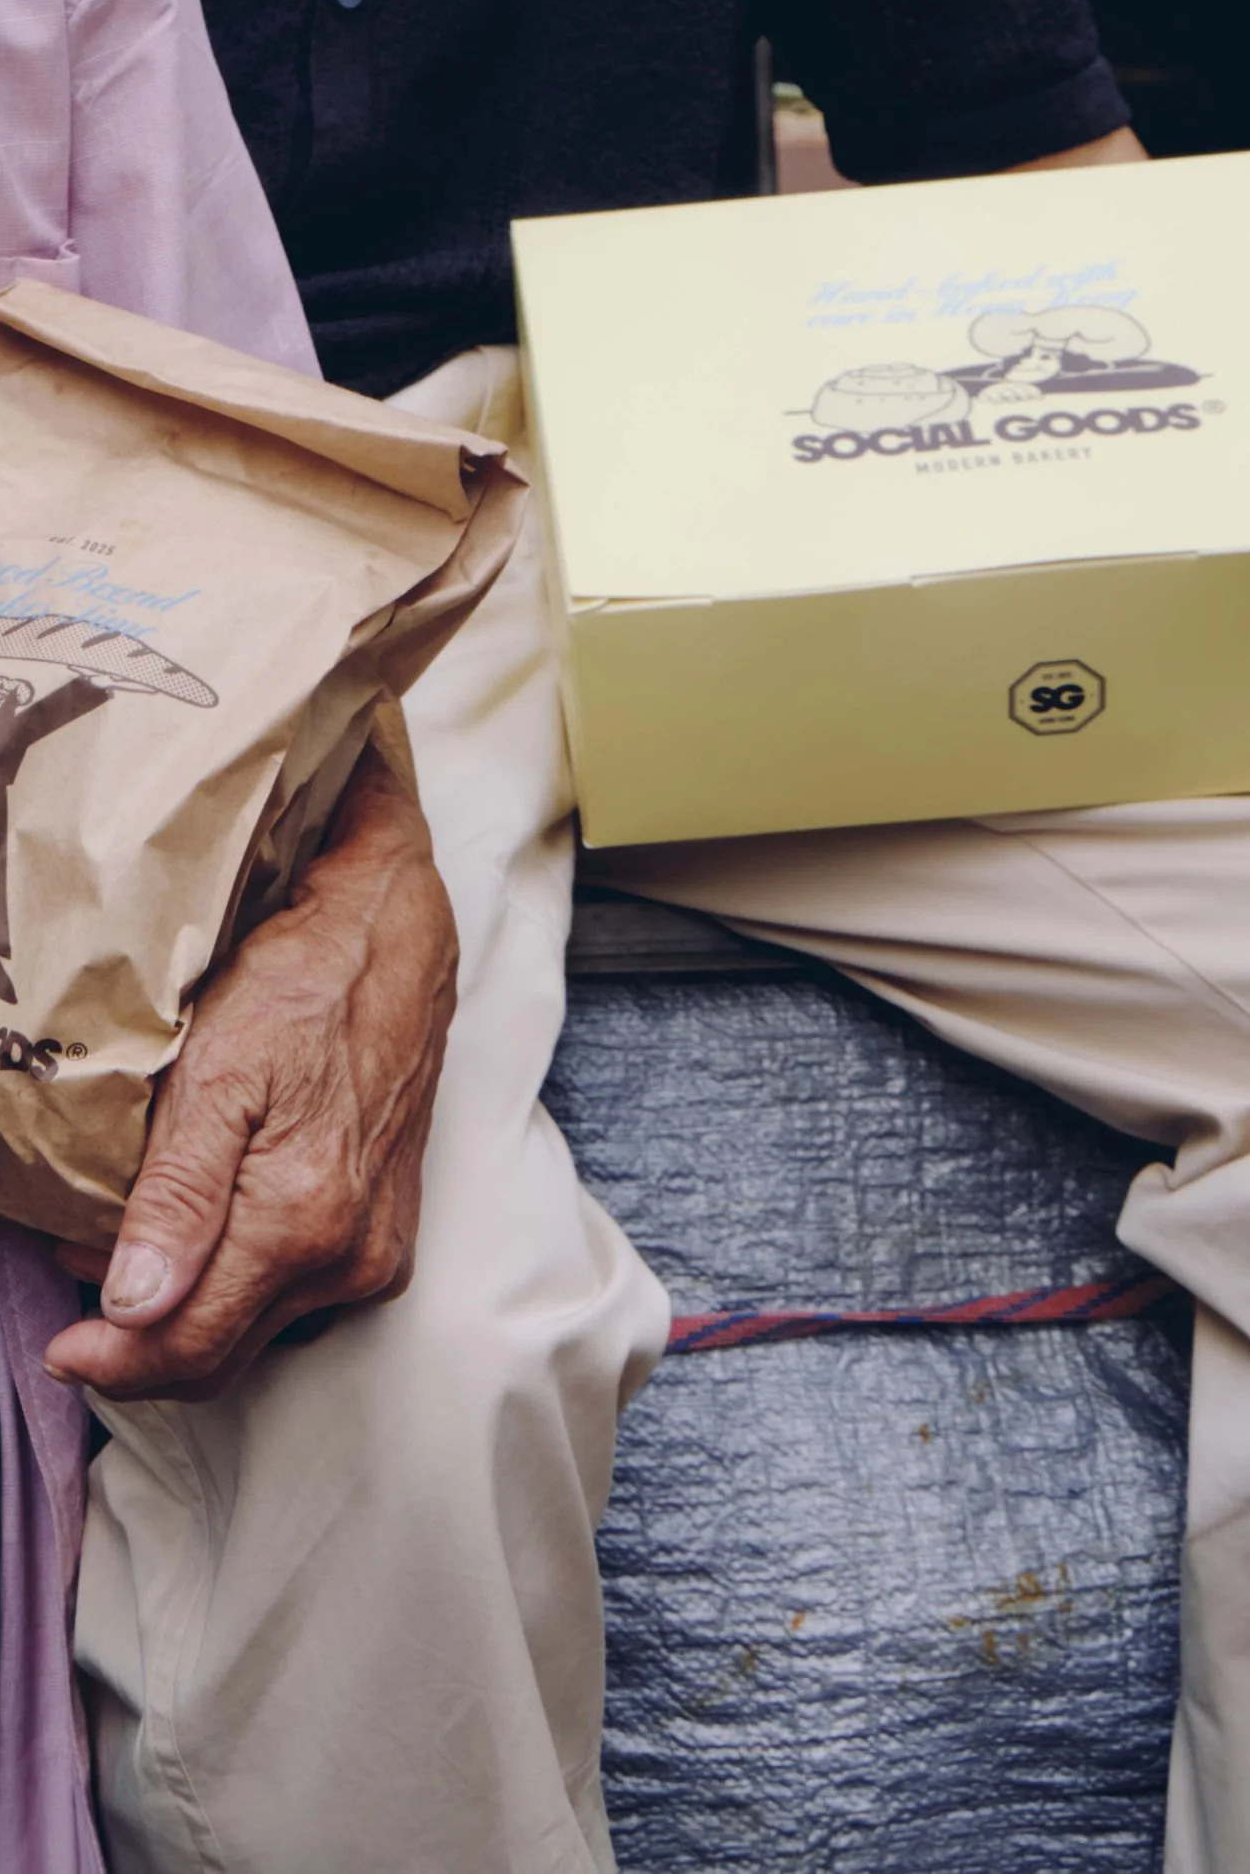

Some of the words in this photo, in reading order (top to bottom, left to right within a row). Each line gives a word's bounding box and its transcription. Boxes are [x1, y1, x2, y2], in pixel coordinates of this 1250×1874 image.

[792, 420, 991, 463] SOCIAL
[915, 455, 1001, 474] MODERN
[1012, 446, 1091, 464] BAKERY
[80, 539, 117, 556] 2025
[47, 560, 202, 612] Bread
[1029, 684, 1085, 713] SG
